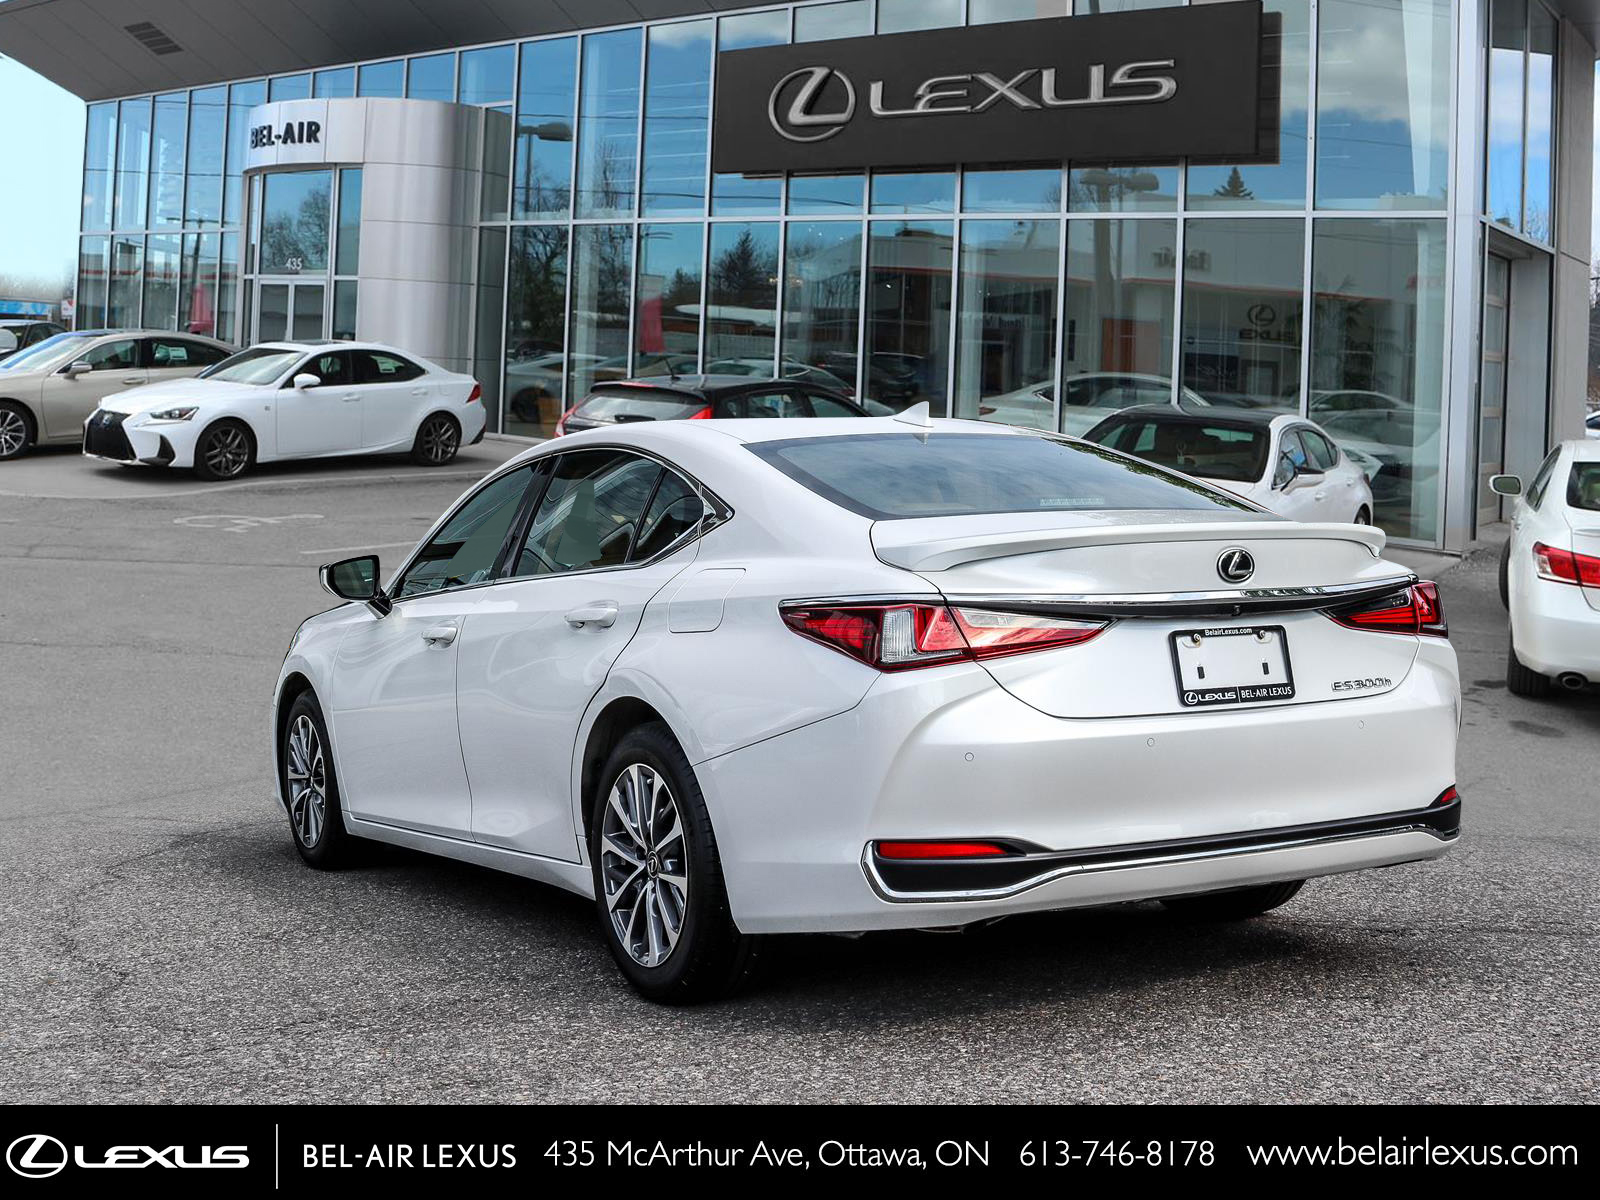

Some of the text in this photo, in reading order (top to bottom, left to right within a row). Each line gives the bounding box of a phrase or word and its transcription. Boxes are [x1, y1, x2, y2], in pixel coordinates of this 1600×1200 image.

[869, 59, 1178, 118] LEXUS
[250, 120, 321, 149] BEL-AIR
[285, 257, 303, 270] 435
[1204, 628, 1253, 636] BelairLexus.com
[1331, 677, 1392, 691] ES300h
[1198, 691, 1236, 702] LEXUS
[1240, 686, 1292, 699] BEL-AIR LEXUS
